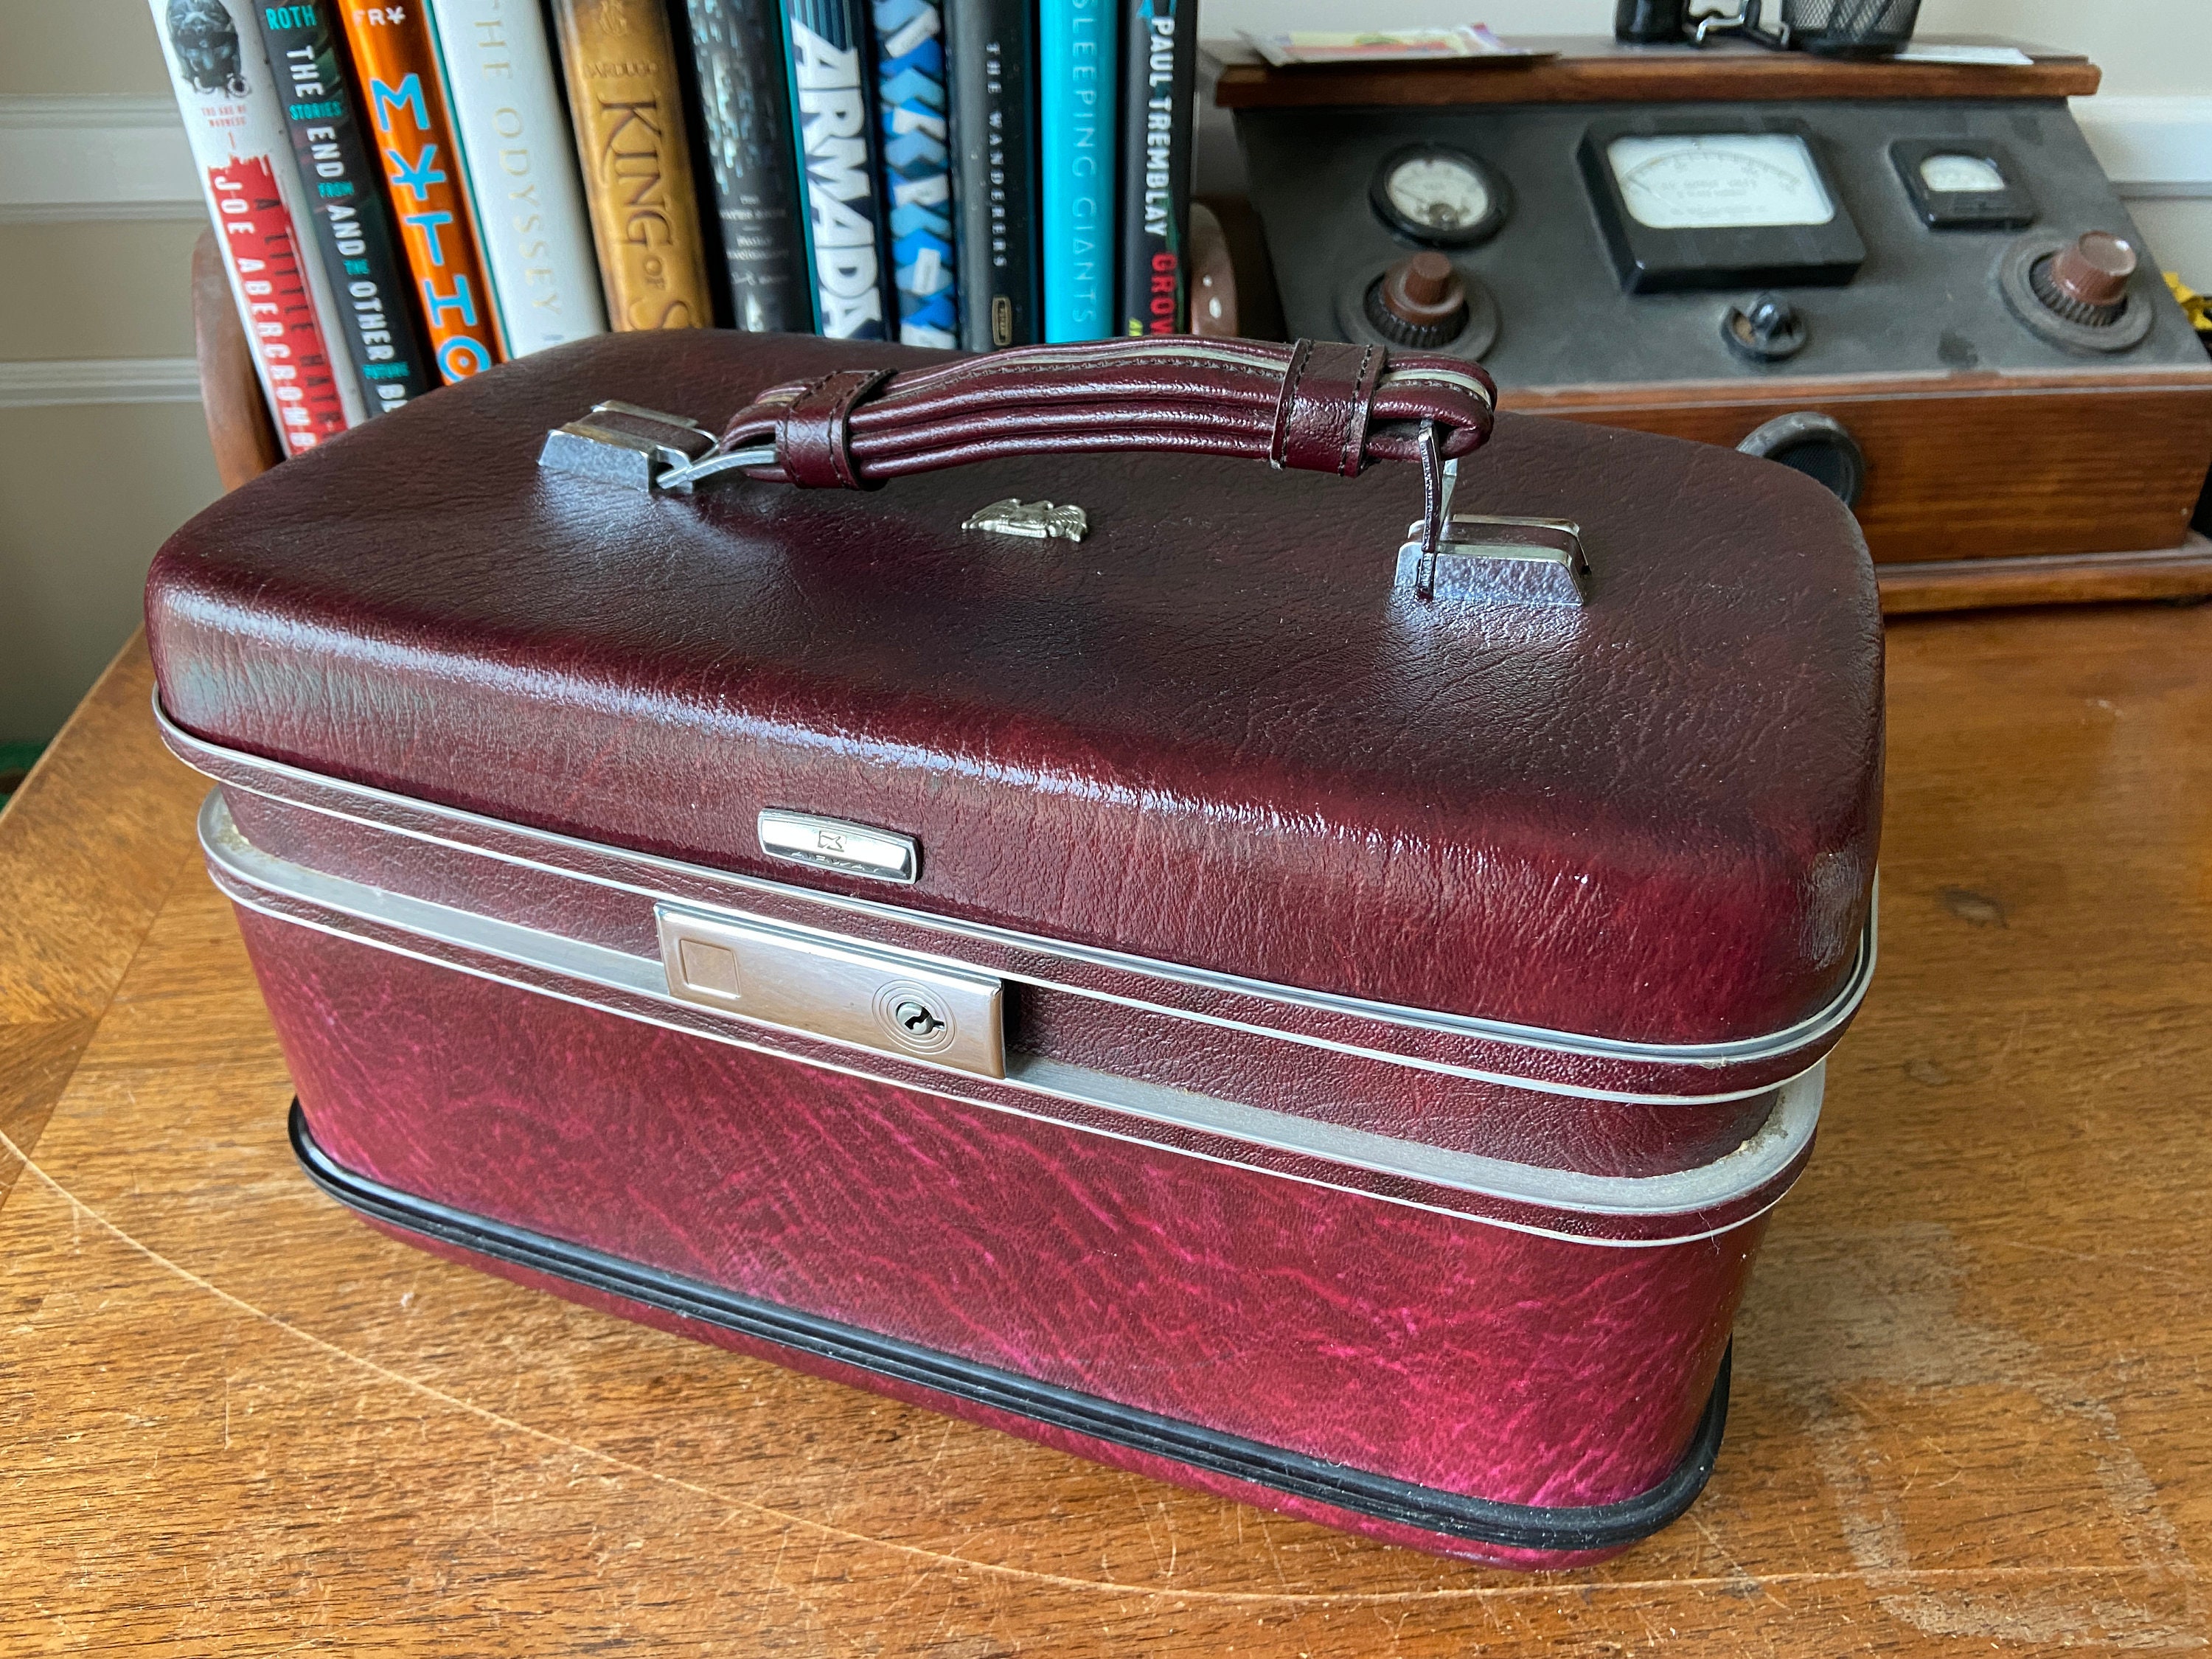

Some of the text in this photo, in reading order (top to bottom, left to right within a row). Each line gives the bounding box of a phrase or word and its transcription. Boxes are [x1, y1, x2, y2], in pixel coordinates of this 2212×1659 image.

[265, 5, 317, 30] ROTH
[1144, 16, 1175, 237] PAUL TREMBLAY
[215, 175, 255, 234] JOE
[254, 198, 282, 212] A
[286, 45, 324, 98] THE
[306, 126, 346, 178] END
[326, 205, 366, 256] AND
[348, 280, 395, 361] OTHER
[369, 72, 492, 384] MYTHO
[474, 0, 563, 316] HE ODYSSEY
[594, 88, 675, 247] KING
[643, 255, 666, 291] OF
[790, 17, 883, 338] ARMADA
[986, 42, 1008, 266] THE WANDERERS
[1072, 196, 1097, 323] GIANTS
